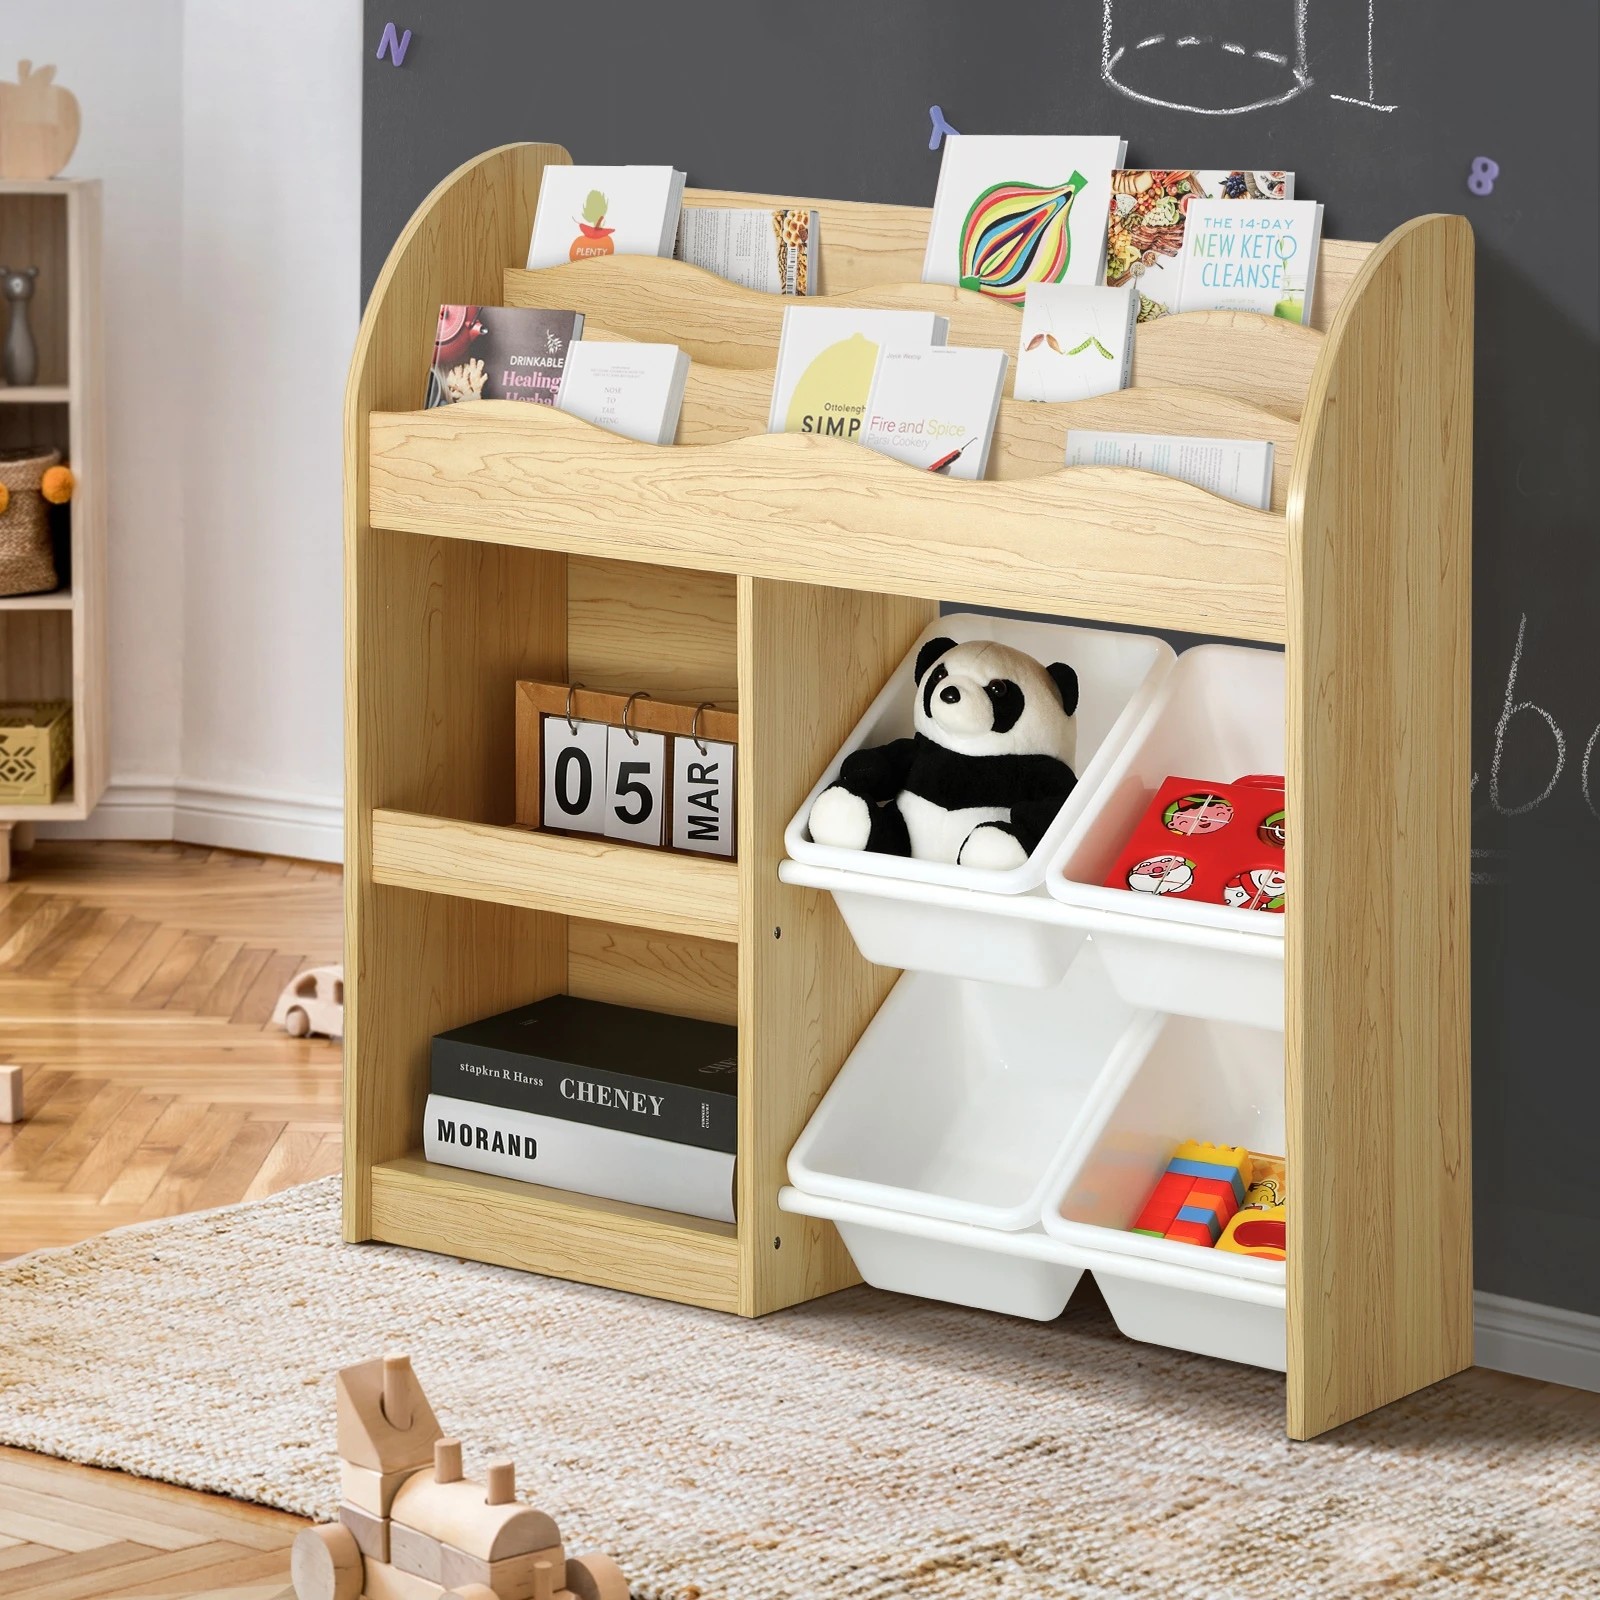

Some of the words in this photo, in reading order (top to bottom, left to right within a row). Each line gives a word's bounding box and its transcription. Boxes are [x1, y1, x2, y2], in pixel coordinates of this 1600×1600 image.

[376, 22, 412, 67] N
[1467, 155, 1500, 196] 8
[1204, 217, 1233, 229] THE
[1240, 219, 1294, 230] 14-DAY
[576, 247, 608, 257] PLENTY
[1193, 233, 1235, 258] NEW
[1240, 234, 1297, 260] KETO
[1202, 262, 1282, 289] CLEANSE
[509, 355, 565, 369] DRINKABLE
[502, 370, 561, 394] Healing
[801, 415, 861, 438] SIMP
[869, 415, 896, 433] Fire
[898, 420, 925, 434] and
[926, 420, 966, 440] Spice
[867, 433, 890, 445] Parsi
[891, 434, 931, 451] Cookery
[687, 762, 720, 842] MAR
[459, 1062, 500, 1077] stapkrn
[502, 1068, 512, 1081] R
[513, 1071, 544, 1087] Harss
[559, 1077, 664, 1117] CHENEY
[437, 1118, 537, 1160] MORAND
